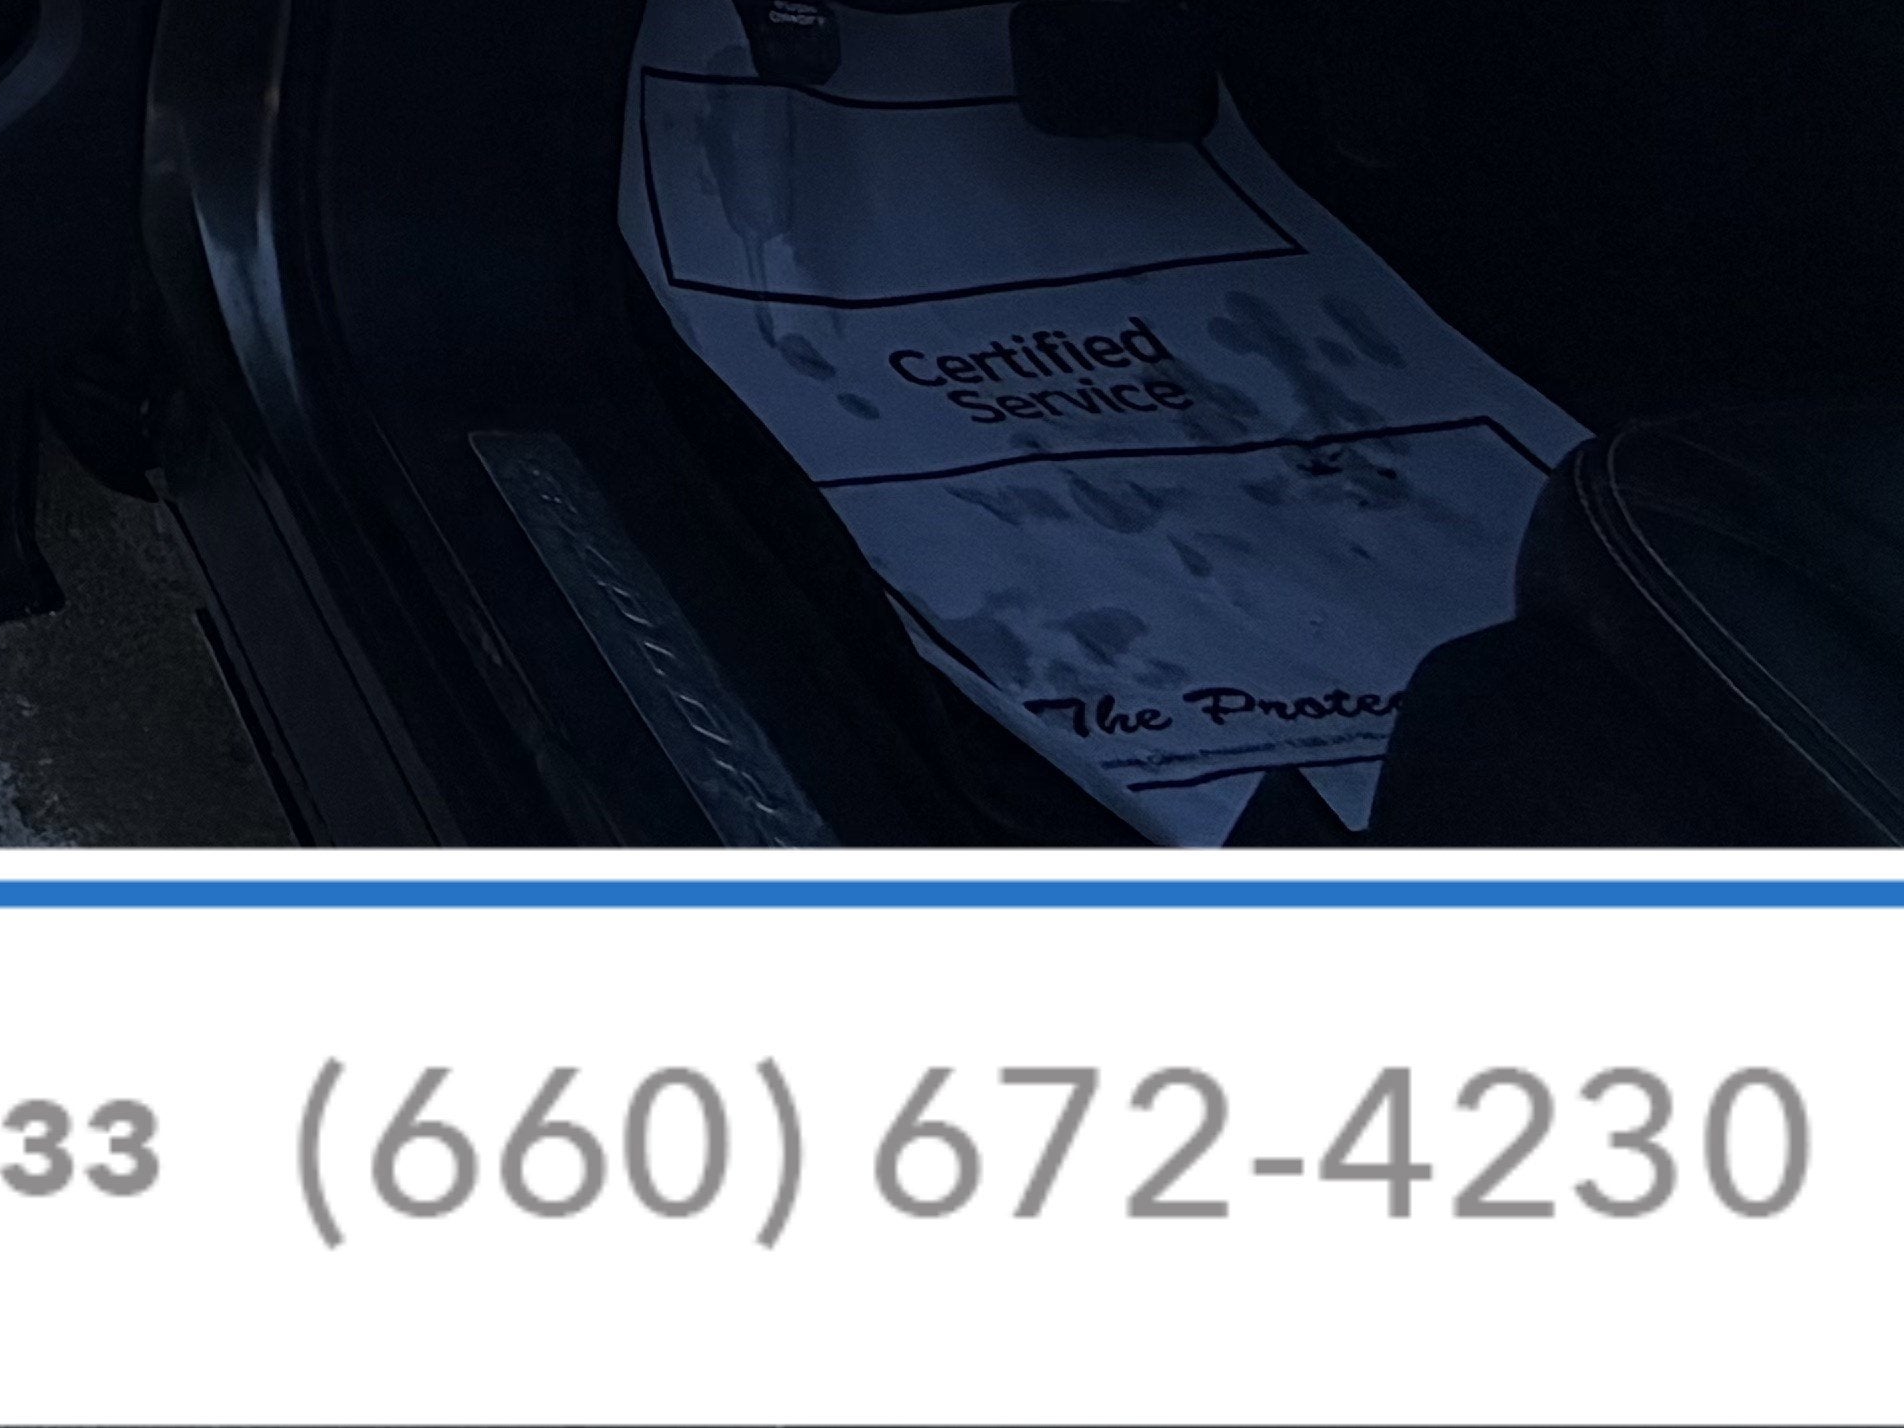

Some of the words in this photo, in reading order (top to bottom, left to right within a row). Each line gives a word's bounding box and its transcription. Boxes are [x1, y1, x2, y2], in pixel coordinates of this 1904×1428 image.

[888, 316, 1175, 388] Certified
[947, 378, 1194, 424] Service
[1024, 695, 1172, 738] The
